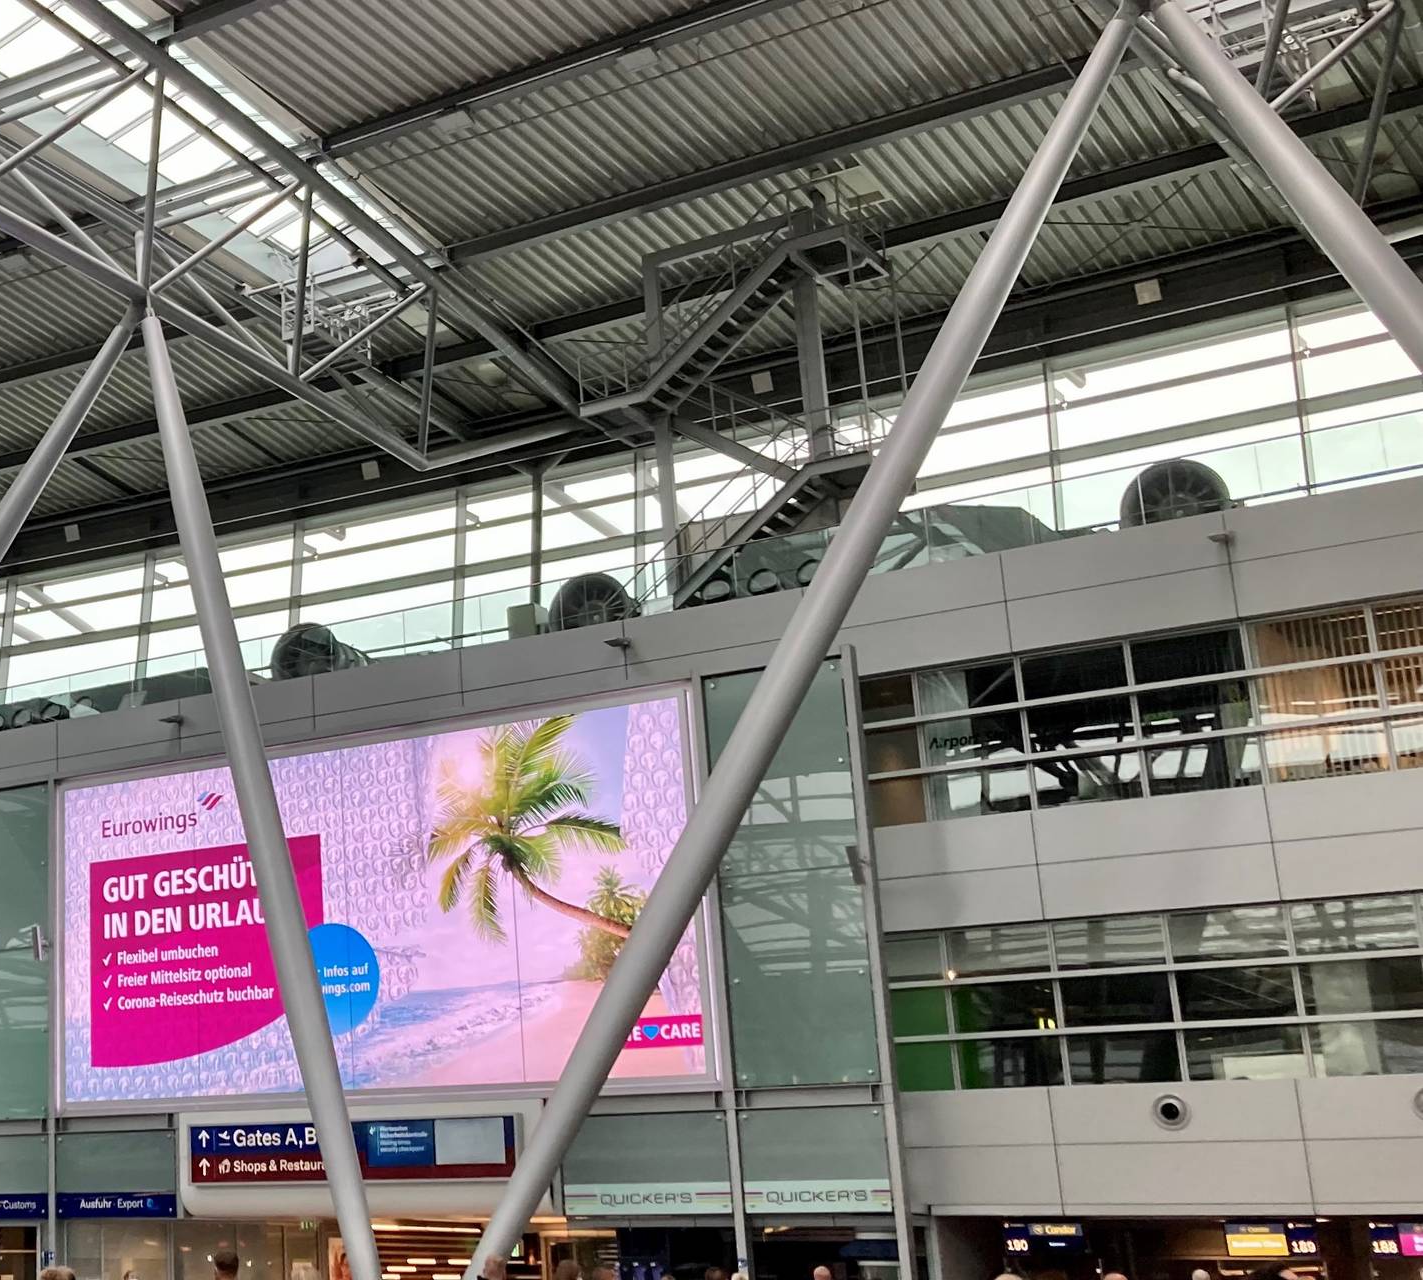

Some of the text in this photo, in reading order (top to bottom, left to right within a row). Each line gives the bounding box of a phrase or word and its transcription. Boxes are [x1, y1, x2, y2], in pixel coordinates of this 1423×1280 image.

[101, 812, 197, 838] Eurowings
[103, 855, 258, 903] GUT GESCHÜT
[103, 897, 266, 940] IN DEN URLAU
[117, 943, 219, 965] Flexibel umbuchen
[117, 962, 252, 988] Freier Mittelsitz optional
[323, 962, 369, 978] Infos auf
[117, 985, 275, 1011] Corona-Reiseschutz buchbar
[321, 981, 371, 997] ings.com
[660, 1022, 701, 1040] CARE
[233, 1128, 281, 1148] Gates
[233, 1157, 325, 1175] Shops & Restaur
[3, 1200, 37, 1211] Customs
[79, 1199, 144, 1210] Ausfuhr Export
[599, 1191, 693, 1207] QUICKER'S
[765, 1188, 869, 1206] QUICKER'S
[1045, 1225, 1076, 1235] Condor
